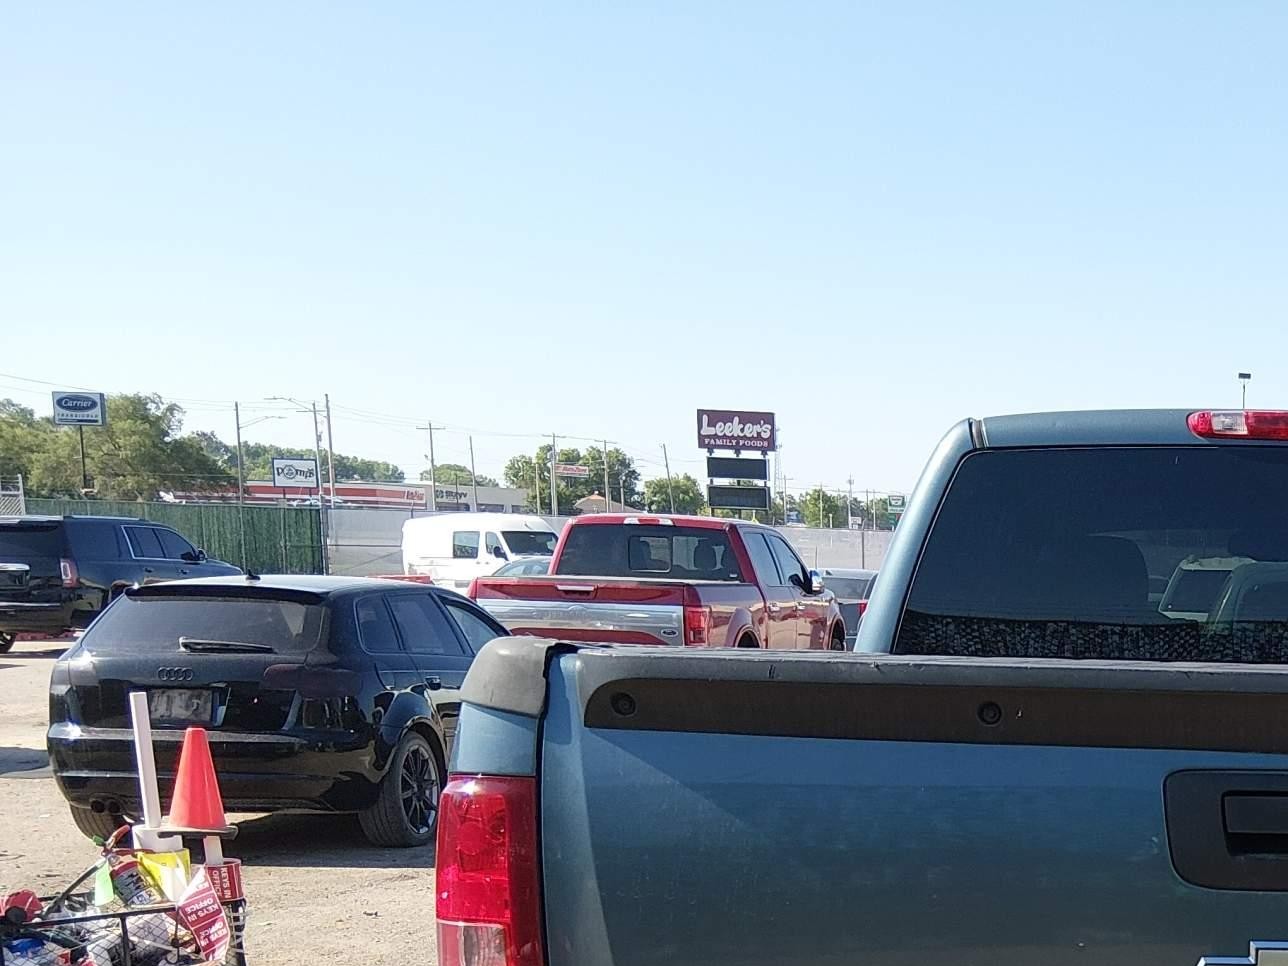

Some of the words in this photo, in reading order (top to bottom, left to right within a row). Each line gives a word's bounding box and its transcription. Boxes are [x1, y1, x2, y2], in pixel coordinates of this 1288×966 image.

[62, 398, 93, 407] Carrier
[700, 414, 772, 439] Leeker's
[704, 438, 737, 446] FAMILY
[739, 439, 768, 447] FOODS
[220, 867, 231, 889] KEYS
[184, 897, 214, 914] OFFICE
[198, 903, 219, 917] KEYS
